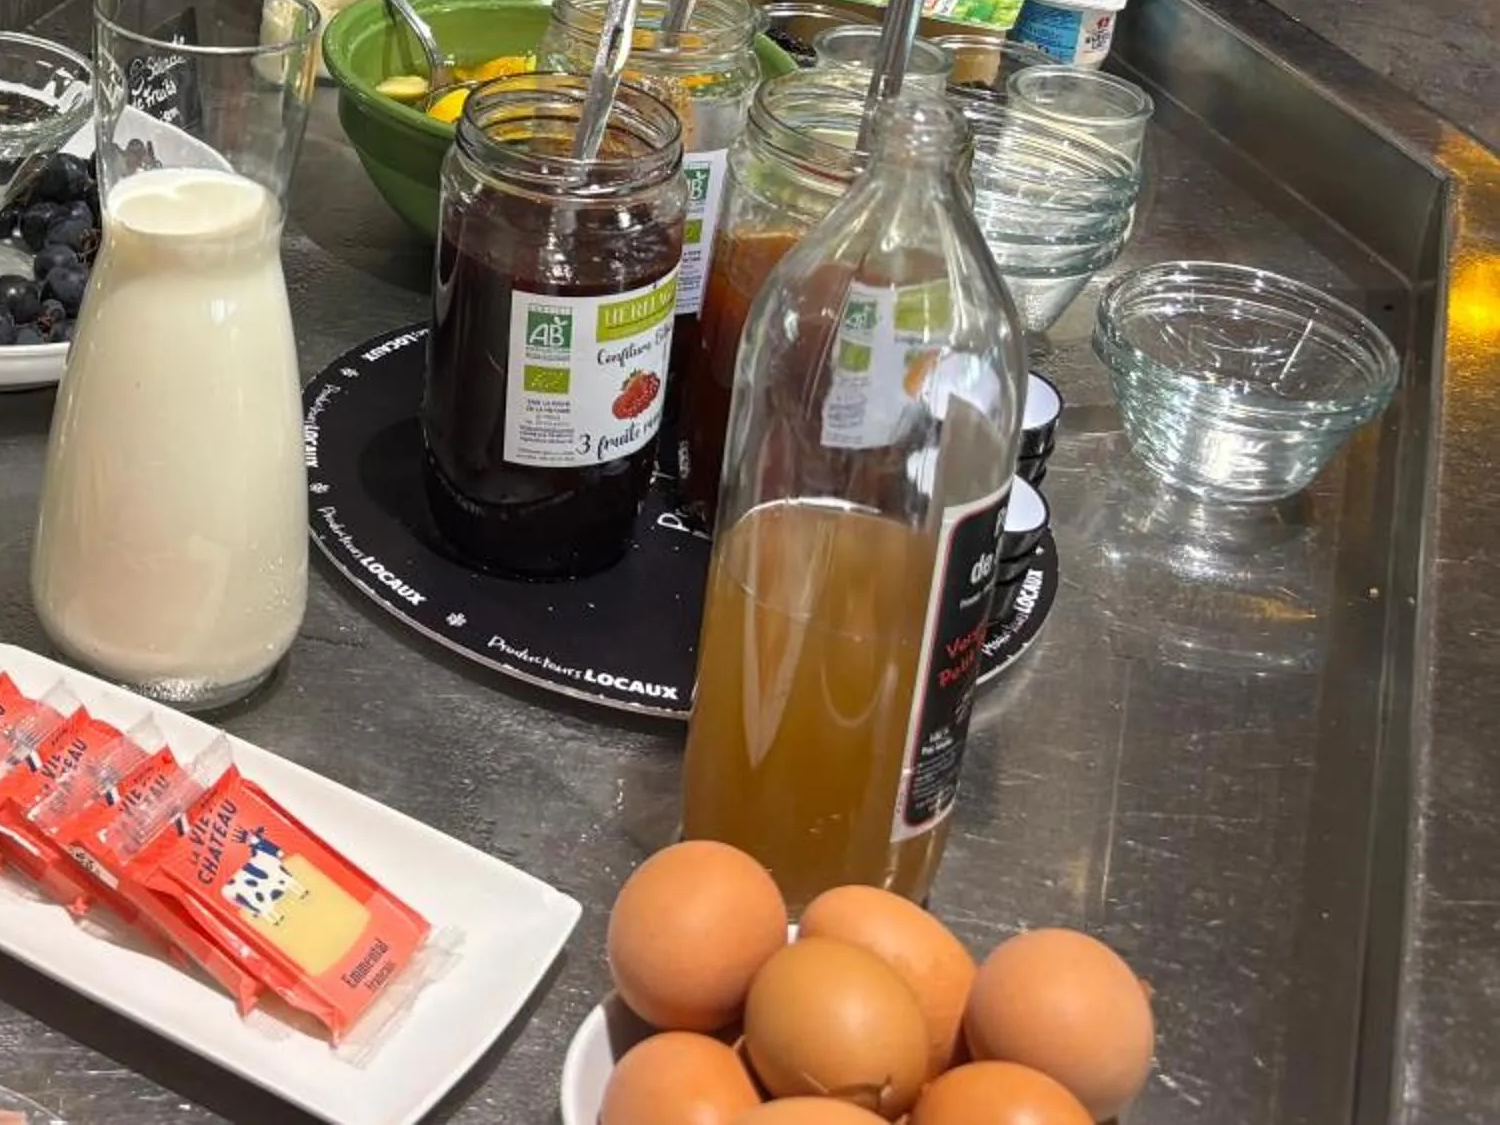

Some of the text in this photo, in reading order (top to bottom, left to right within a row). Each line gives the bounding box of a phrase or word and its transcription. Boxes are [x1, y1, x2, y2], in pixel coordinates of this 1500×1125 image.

[575, 432, 591, 456] 3
[359, 556, 427, 607] LOCAUX
[583, 668, 679, 701] LOCAUX
[188, 815, 213, 846] VIE
[196, 797, 238, 885] CHATEAU
